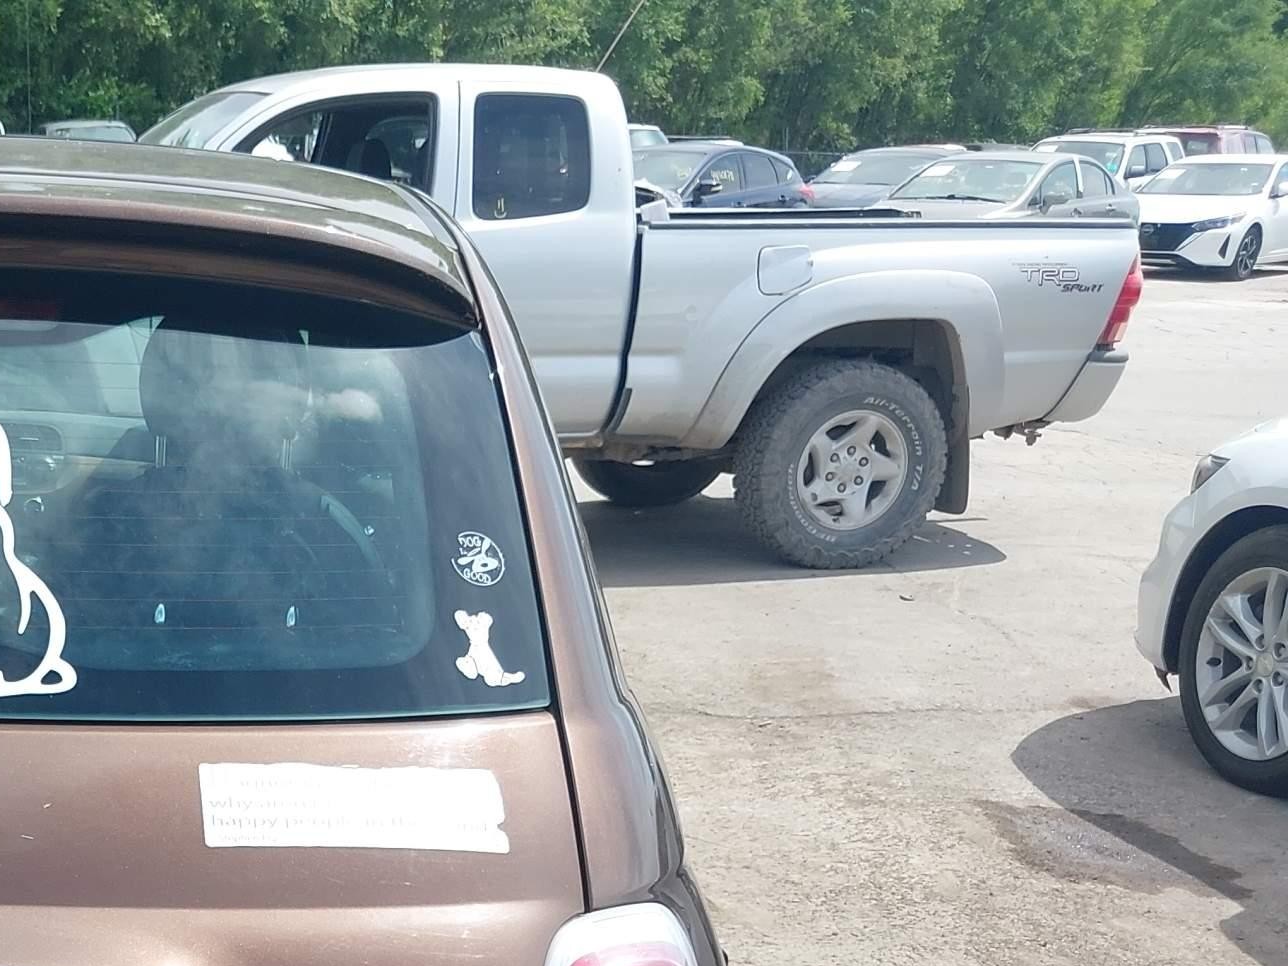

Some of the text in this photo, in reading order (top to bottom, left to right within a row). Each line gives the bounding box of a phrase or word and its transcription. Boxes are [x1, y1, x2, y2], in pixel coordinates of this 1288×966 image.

[1020, 267, 1081, 287] TRD
[911, 463, 924, 491] T/A
[463, 568, 492, 584] GOOD
[211, 814, 278, 830] happy
